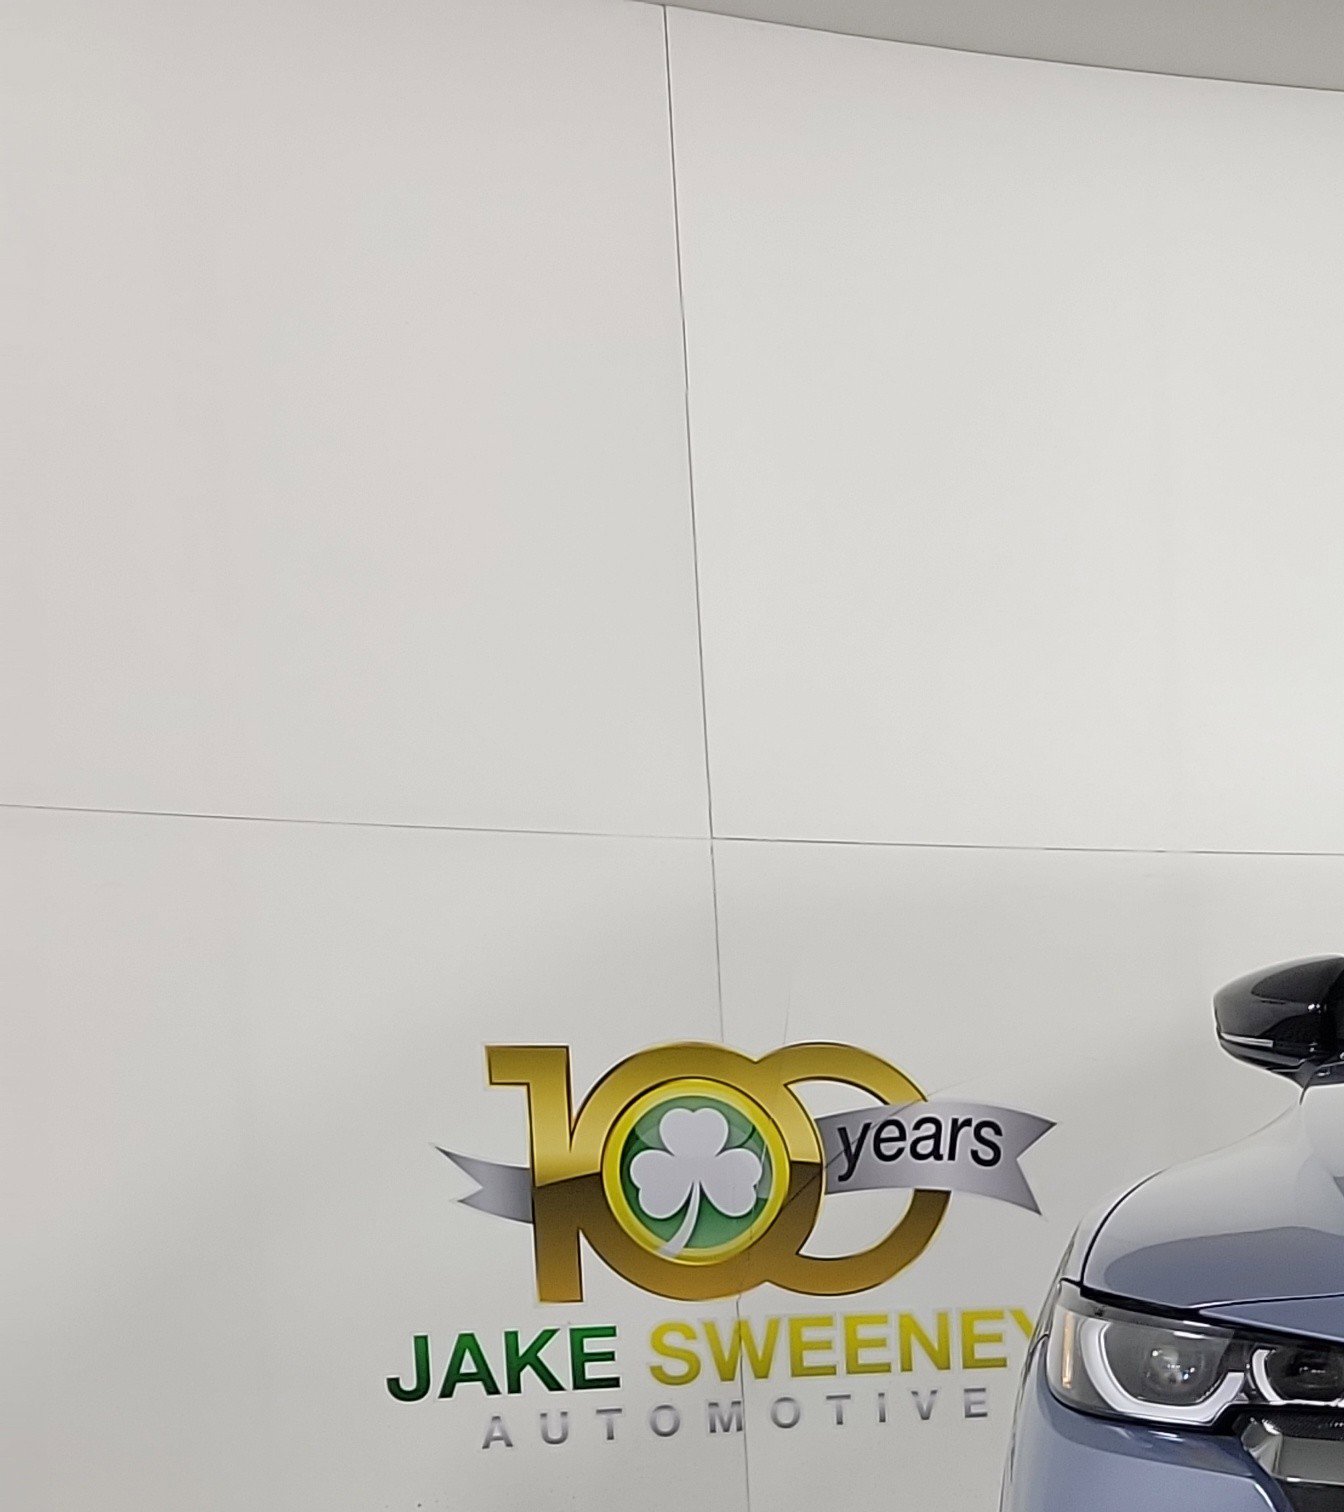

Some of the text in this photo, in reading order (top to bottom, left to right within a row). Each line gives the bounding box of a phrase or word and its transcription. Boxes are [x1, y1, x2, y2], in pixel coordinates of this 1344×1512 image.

[485, 1042, 951, 1302] 100
[836, 1115, 1004, 1182] years
[386, 1325, 622, 1403] JAKE
[481, 1387, 989, 1450] AUTOMOTIVE
